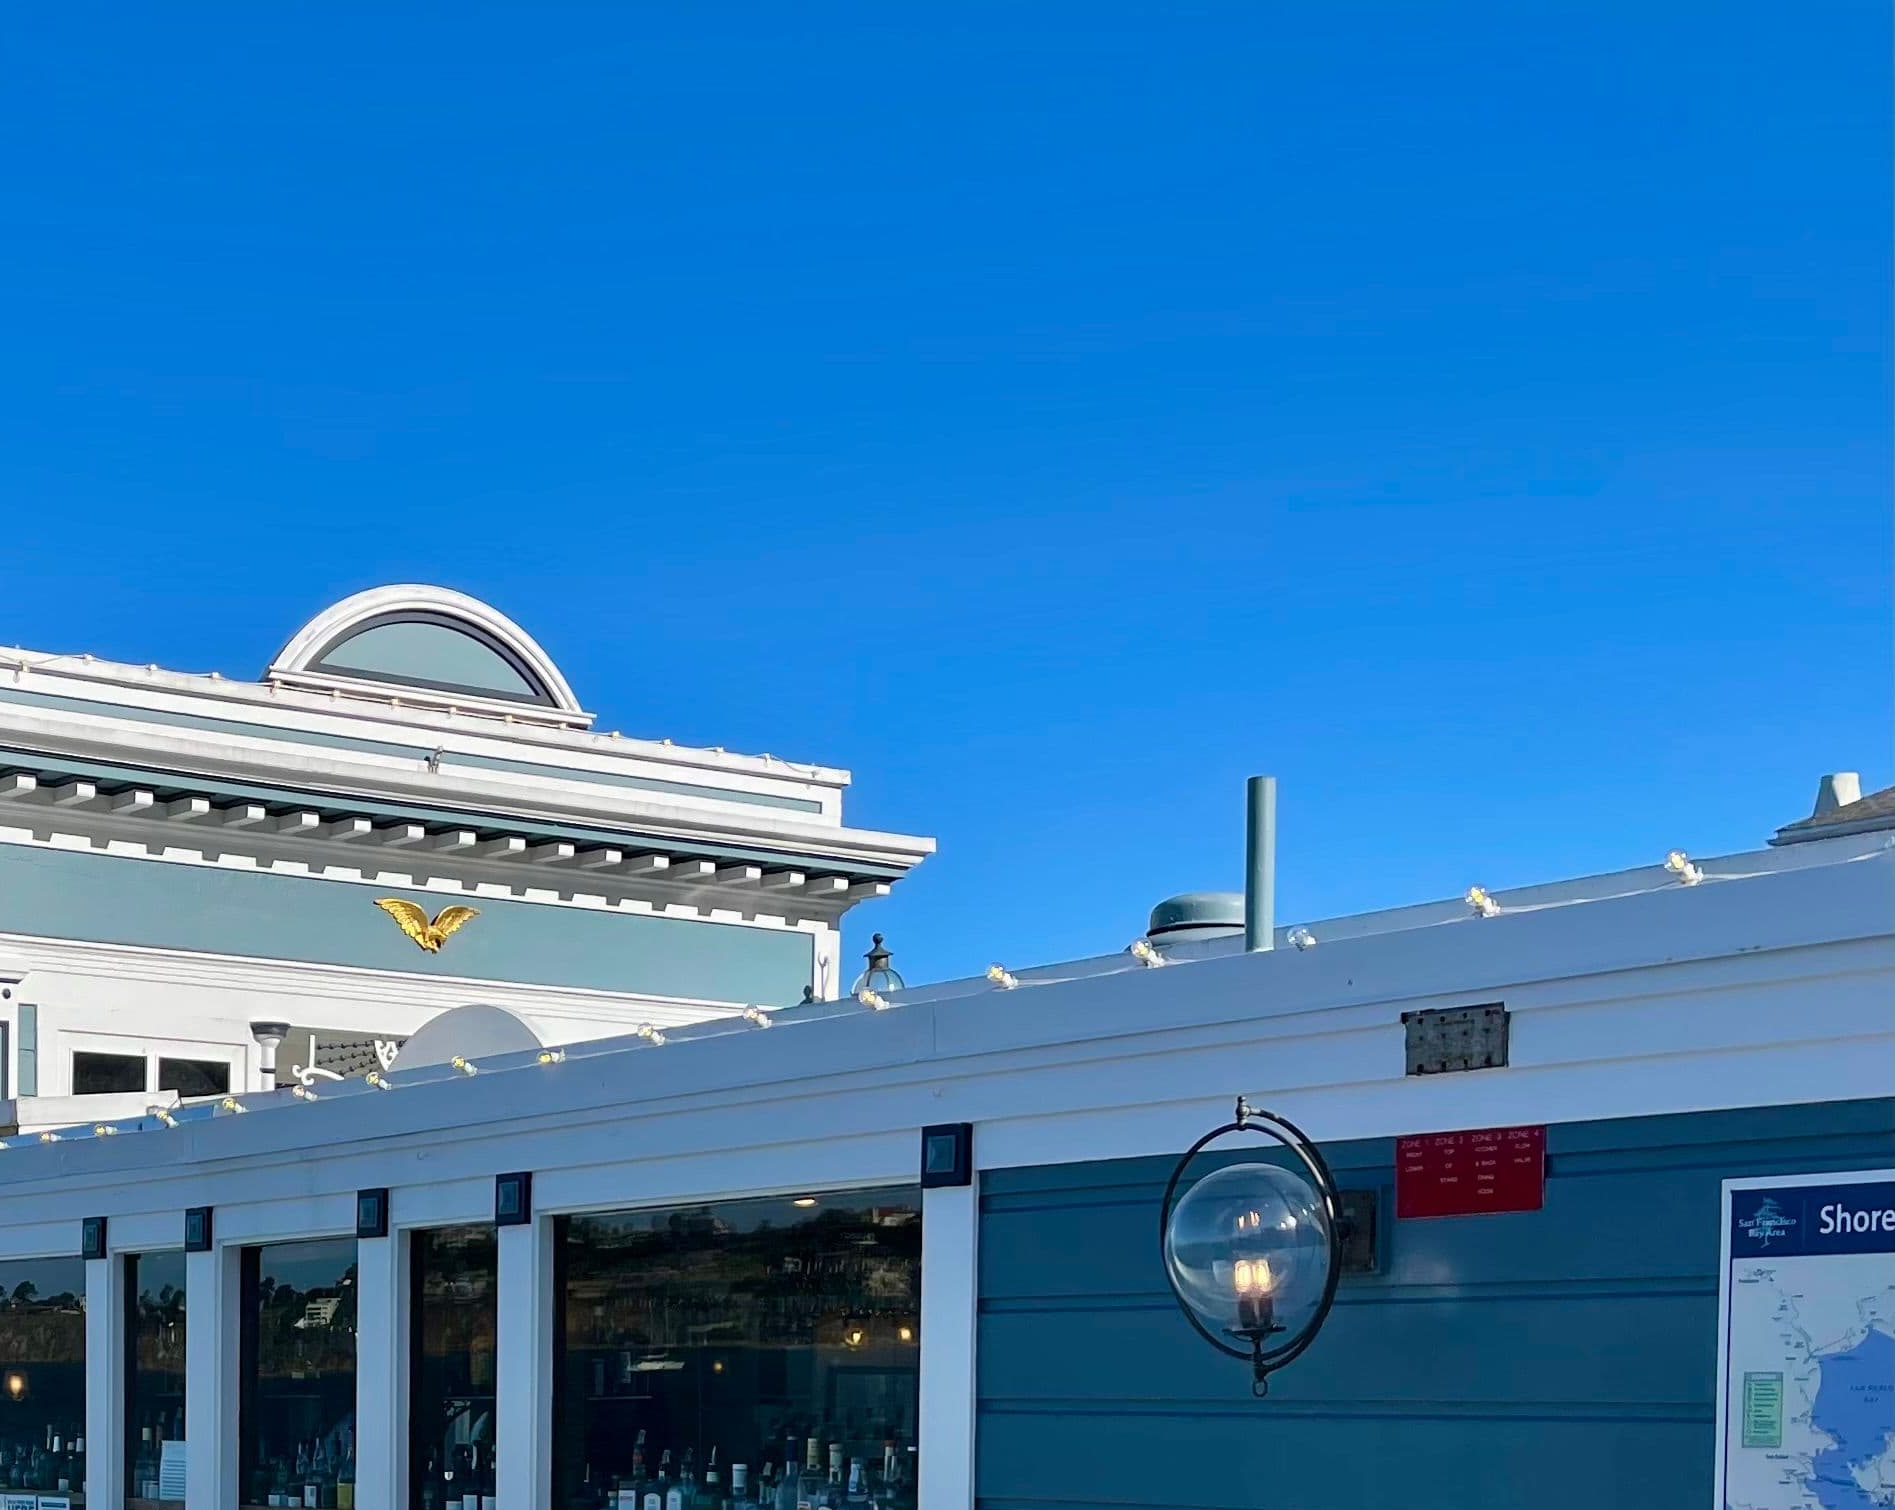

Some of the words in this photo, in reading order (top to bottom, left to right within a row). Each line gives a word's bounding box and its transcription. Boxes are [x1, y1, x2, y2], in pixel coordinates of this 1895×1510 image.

[1738, 1219, 1754, 1228] San
[1756, 1217, 1797, 1227] Francisco
[1819, 1203, 1895, 1235] Shore
[1748, 1229, 1764, 1239] Bay
[1766, 1228, 1786, 1237] Area
